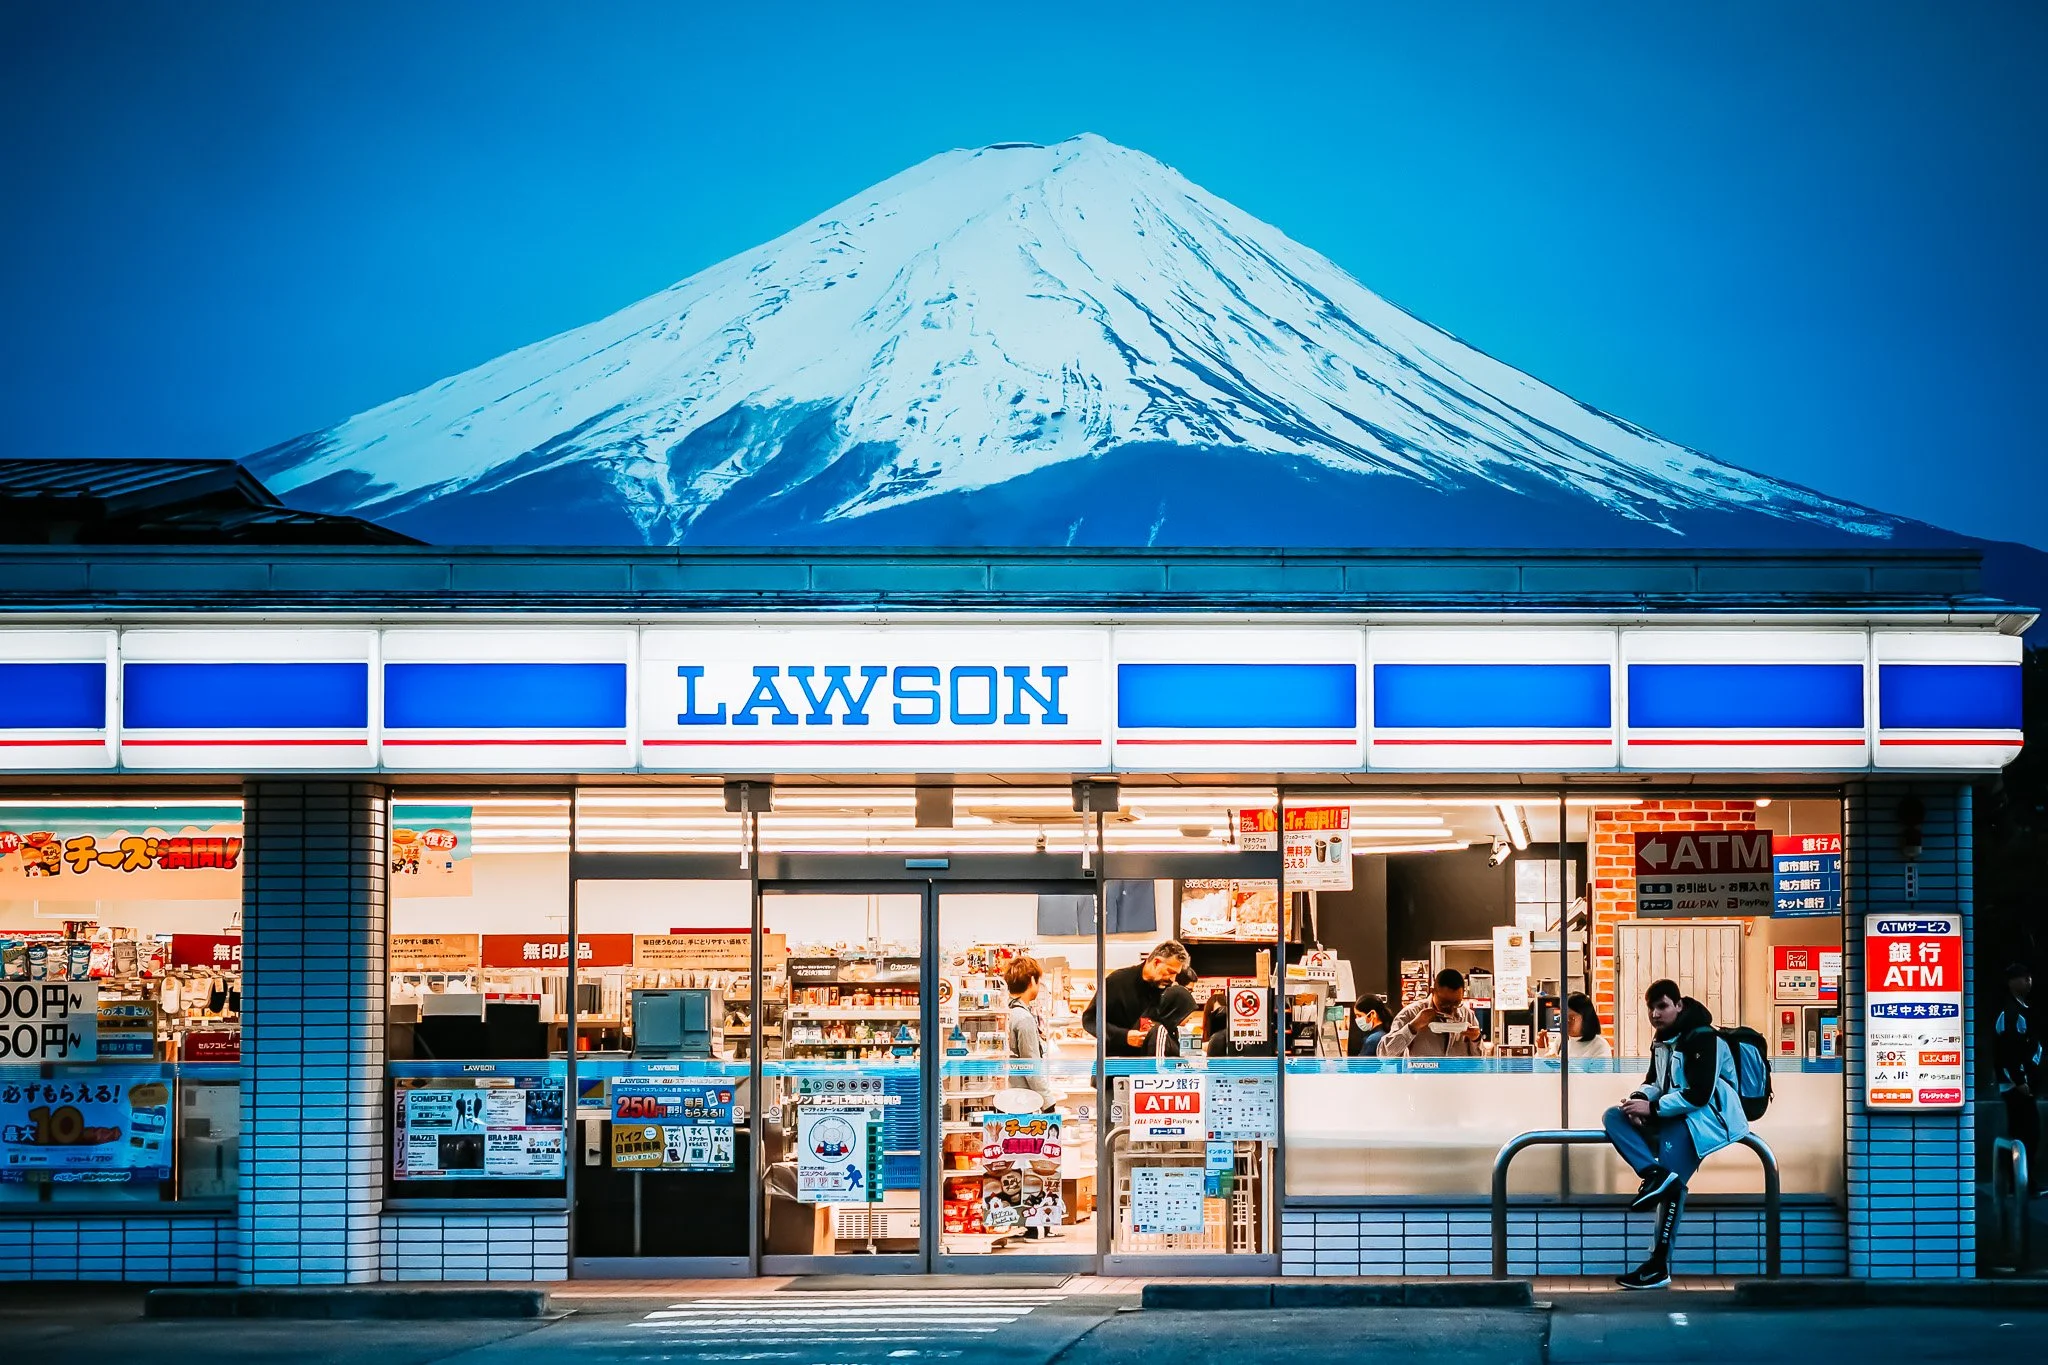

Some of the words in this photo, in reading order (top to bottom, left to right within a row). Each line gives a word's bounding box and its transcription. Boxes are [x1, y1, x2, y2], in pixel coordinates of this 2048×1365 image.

[678, 666, 1068, 725] LAWSON
[425, 832, 454, 849] 復活
[64, 836, 242, 874] チーズ満開!
[1670, 835, 1769, 870] ATM
[1778, 861, 1820, 872] 都市銀行
[1779, 879, 1820, 891] 地方銀行
[1642, 902, 1670, 910] チャージ
[1700, 900, 1719, 909] PAY
[1739, 899, 1770, 909] PayPay
[1777, 897, 1825, 909] ネット銀行
[1881, 922, 1947, 932] ATMサービス
[1888, 942, 1942, 963] 銀行
[1788, 960, 1806, 968] ATM
[1883, 966, 1943, 987] ATM
[1873, 1004, 1956, 1017] 山梨中央銀行
[1921, 1053, 1957, 1063] じぶん銀行
[463, 1064, 496, 1072] LAWSON
[1134, 1078, 1200, 1090] ローソン銀行
[2, 1084, 121, 1104] 必ずもらえる!
[410, 1095, 453, 1103] COMPLEX
[684, 1097, 704, 1108] 毎月
[1144, 1095, 1191, 1111] ATM
[684, 1108, 725, 1118] もらえる!!
[4, 1127, 36, 1142] 最大
[29, 1106, 85, 1144] 10
[1005, 1119, 1048, 1137] チーズ
[409, 1134, 436, 1142] MAZZEL
[615, 1131, 643, 1143] バイク
[983, 1145, 1002, 1159] 新作
[1661, 1201, 1676, 1244] RUNNING
